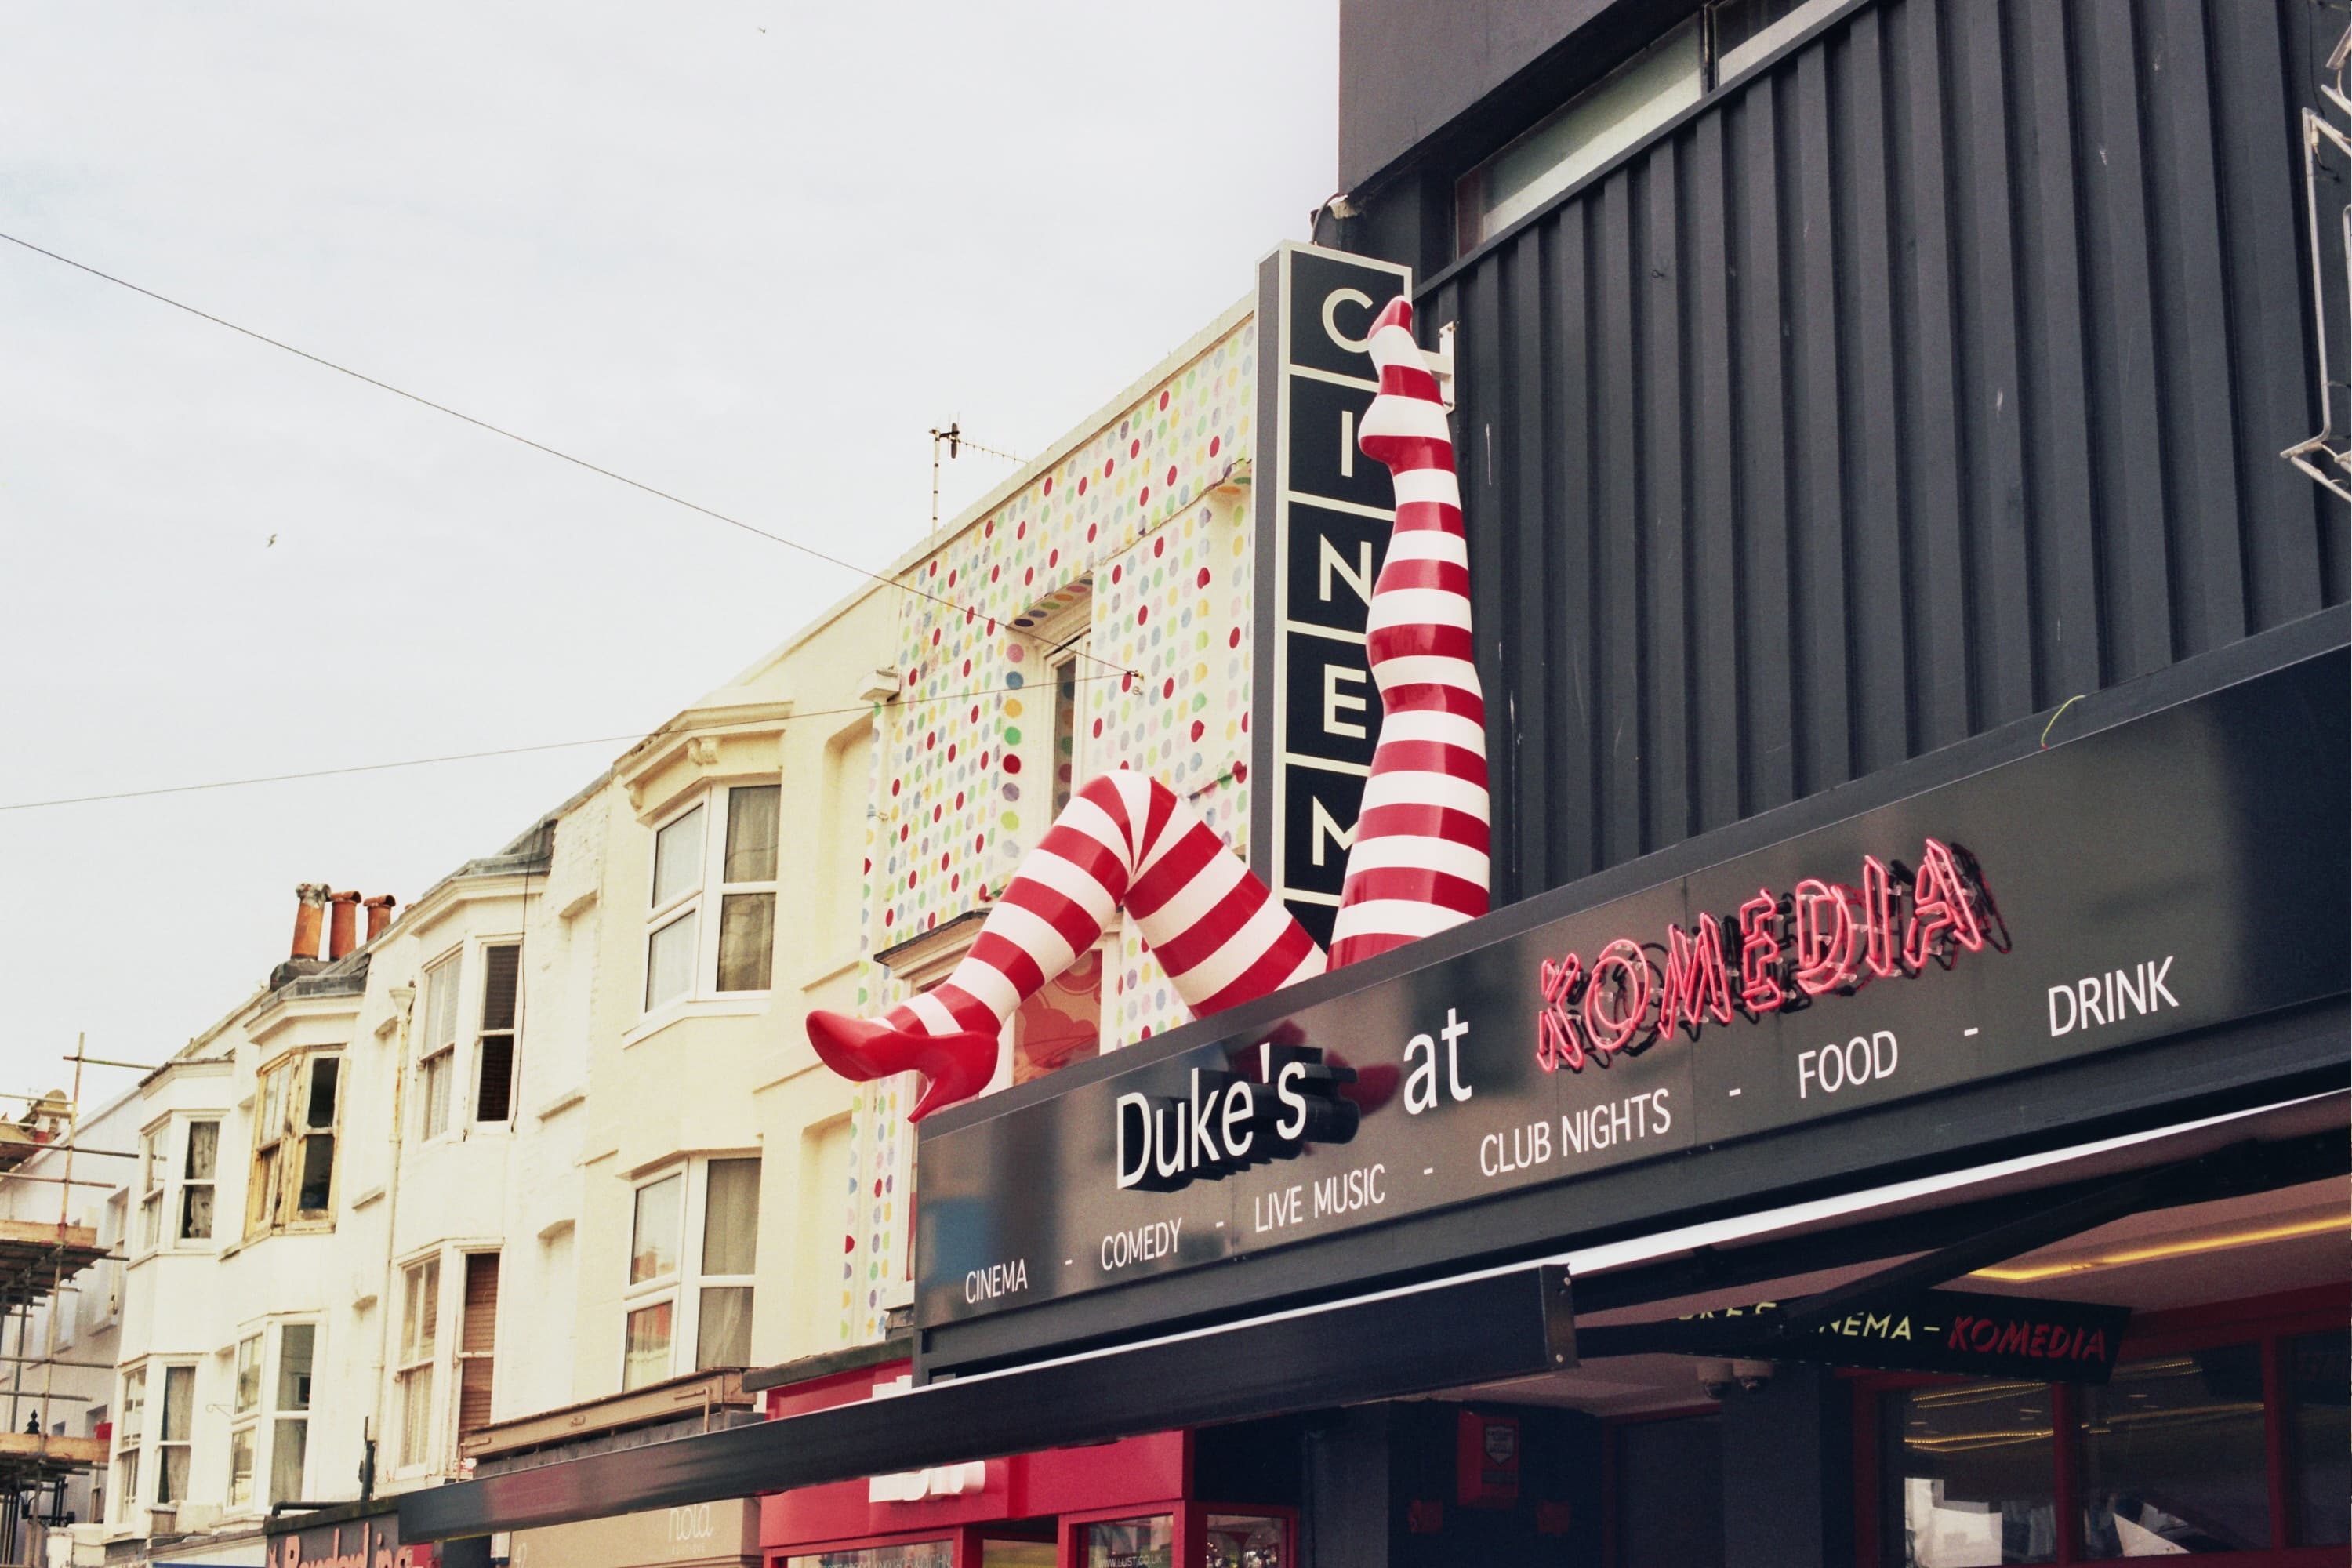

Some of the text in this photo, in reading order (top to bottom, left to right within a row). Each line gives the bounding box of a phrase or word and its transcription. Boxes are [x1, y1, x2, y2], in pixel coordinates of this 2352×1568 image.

[1312, 287, 1374, 866] CINEM
[965, 1258, 1028, 1304] CINEMA
[1101, 1216, 1183, 1271] COMEDY
[1254, 1185, 1304, 1233] LIVE
[1314, 1163, 1385, 1218] MUSIC
[1480, 1121, 1552, 1177] CLUB
[1562, 1088, 1671, 1157] NIGHTS
[1798, 1030, 1898, 1098] FOOD
[2048, 956, 2180, 1037] DRINK
[1116, 838, 1983, 1189] Duke's at KOMEDIA
[1947, 1316, 2107, 1362] KOMEDIA
